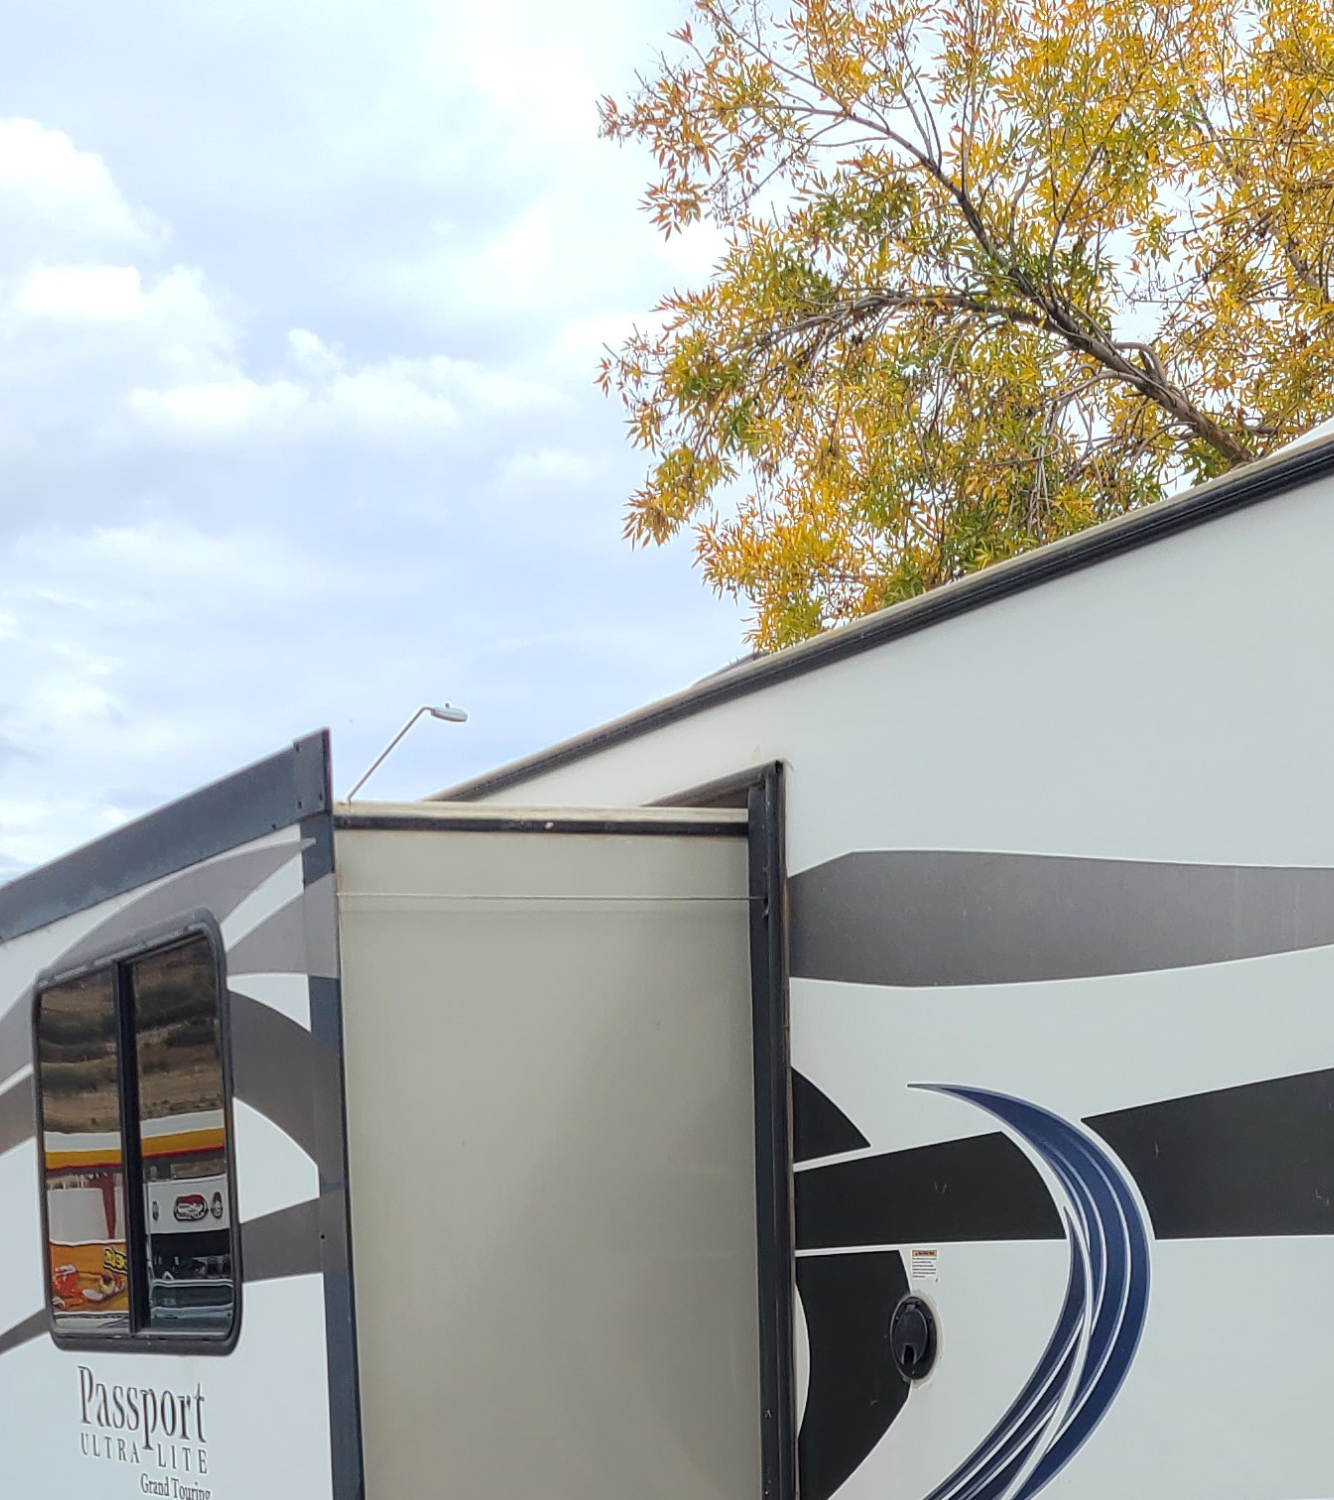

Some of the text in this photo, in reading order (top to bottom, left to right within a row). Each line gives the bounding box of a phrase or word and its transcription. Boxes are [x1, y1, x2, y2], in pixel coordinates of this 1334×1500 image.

[77, 1365, 207, 1450] Passport
[80, 1432, 208, 1474] ULTRA LITE
[140, 1473, 169, 1497] Grand
